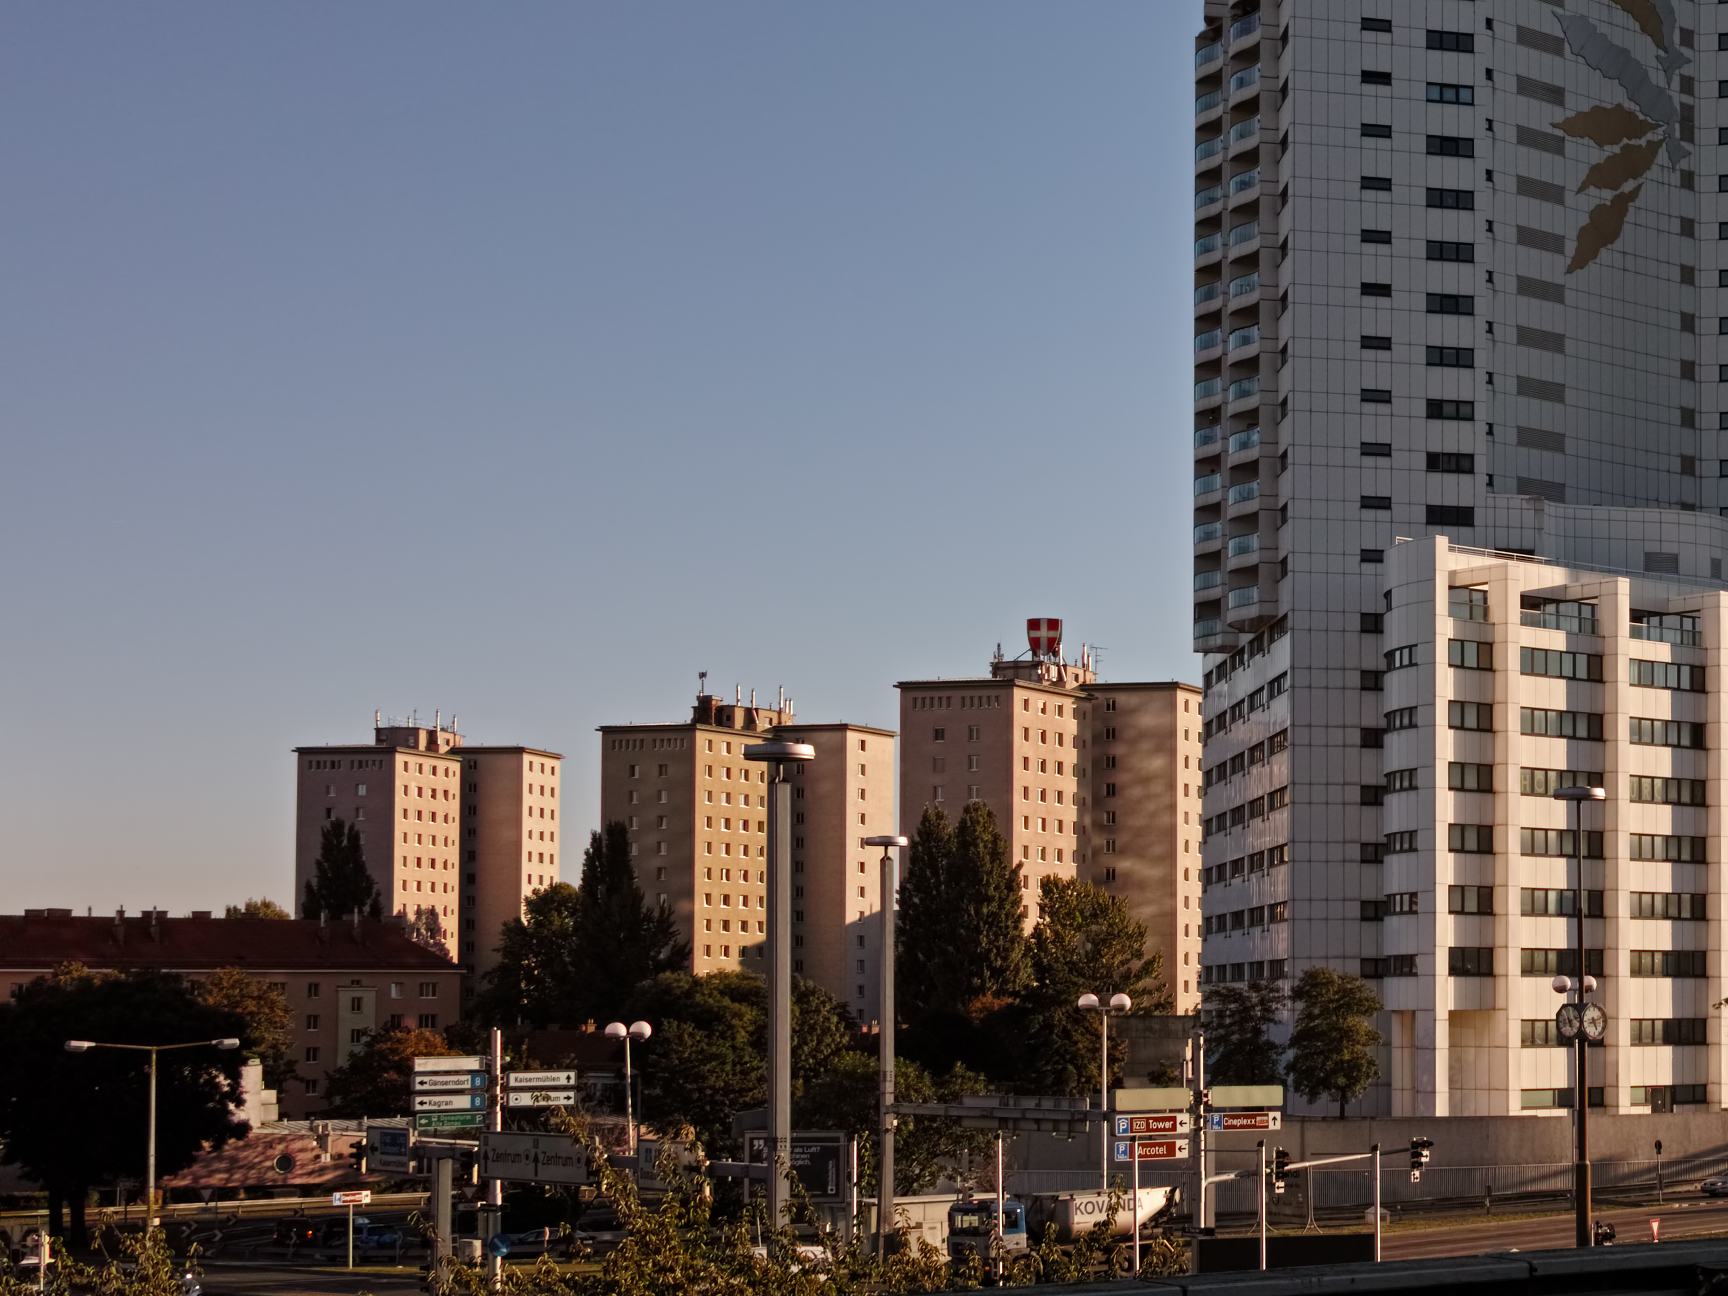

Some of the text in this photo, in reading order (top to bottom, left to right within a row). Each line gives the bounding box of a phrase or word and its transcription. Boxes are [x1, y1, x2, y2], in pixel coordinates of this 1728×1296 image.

[429, 1077, 481, 1087] Gänserndorf 8
[514, 1075, 561, 1083] Kaisermühlen
[428, 1097, 481, 1108] Kagran 8
[1148, 1119, 1174, 1130] Tower
[1223, 1117, 1256, 1127] Cineplexx
[1138, 1145, 1167, 1155] Arcotel
[491, 1148, 523, 1164] Zentrum
[541, 1150, 574, 1167] Zentrum
